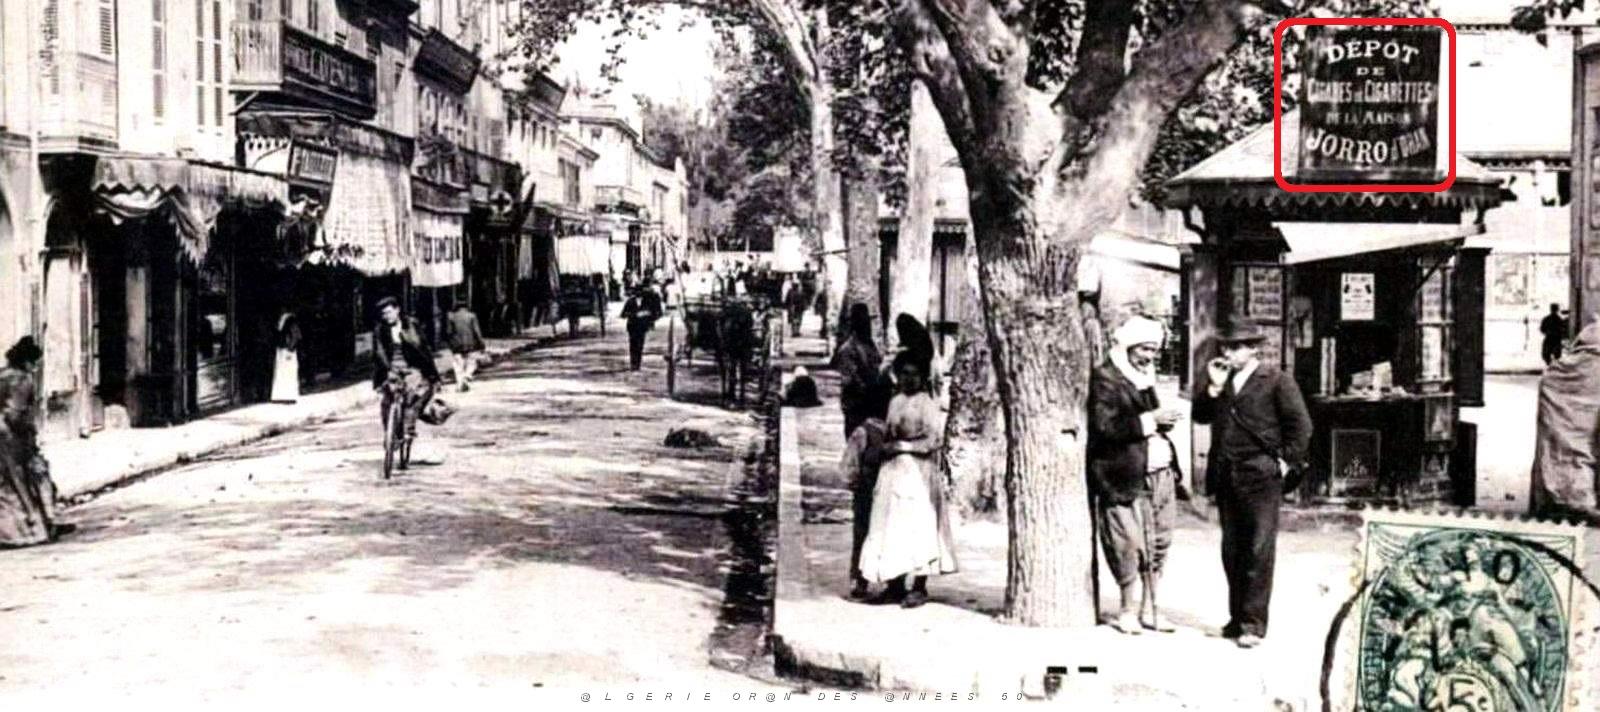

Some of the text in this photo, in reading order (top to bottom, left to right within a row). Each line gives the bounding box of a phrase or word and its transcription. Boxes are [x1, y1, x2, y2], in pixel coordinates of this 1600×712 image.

[1356, 66, 1385, 76] DE
[1364, 79, 1433, 104] CIGARETTES
[1326, 112, 1340, 125] DE
[1345, 112, 1358, 125] LA
[1306, 128, 1388, 163] JORRO
